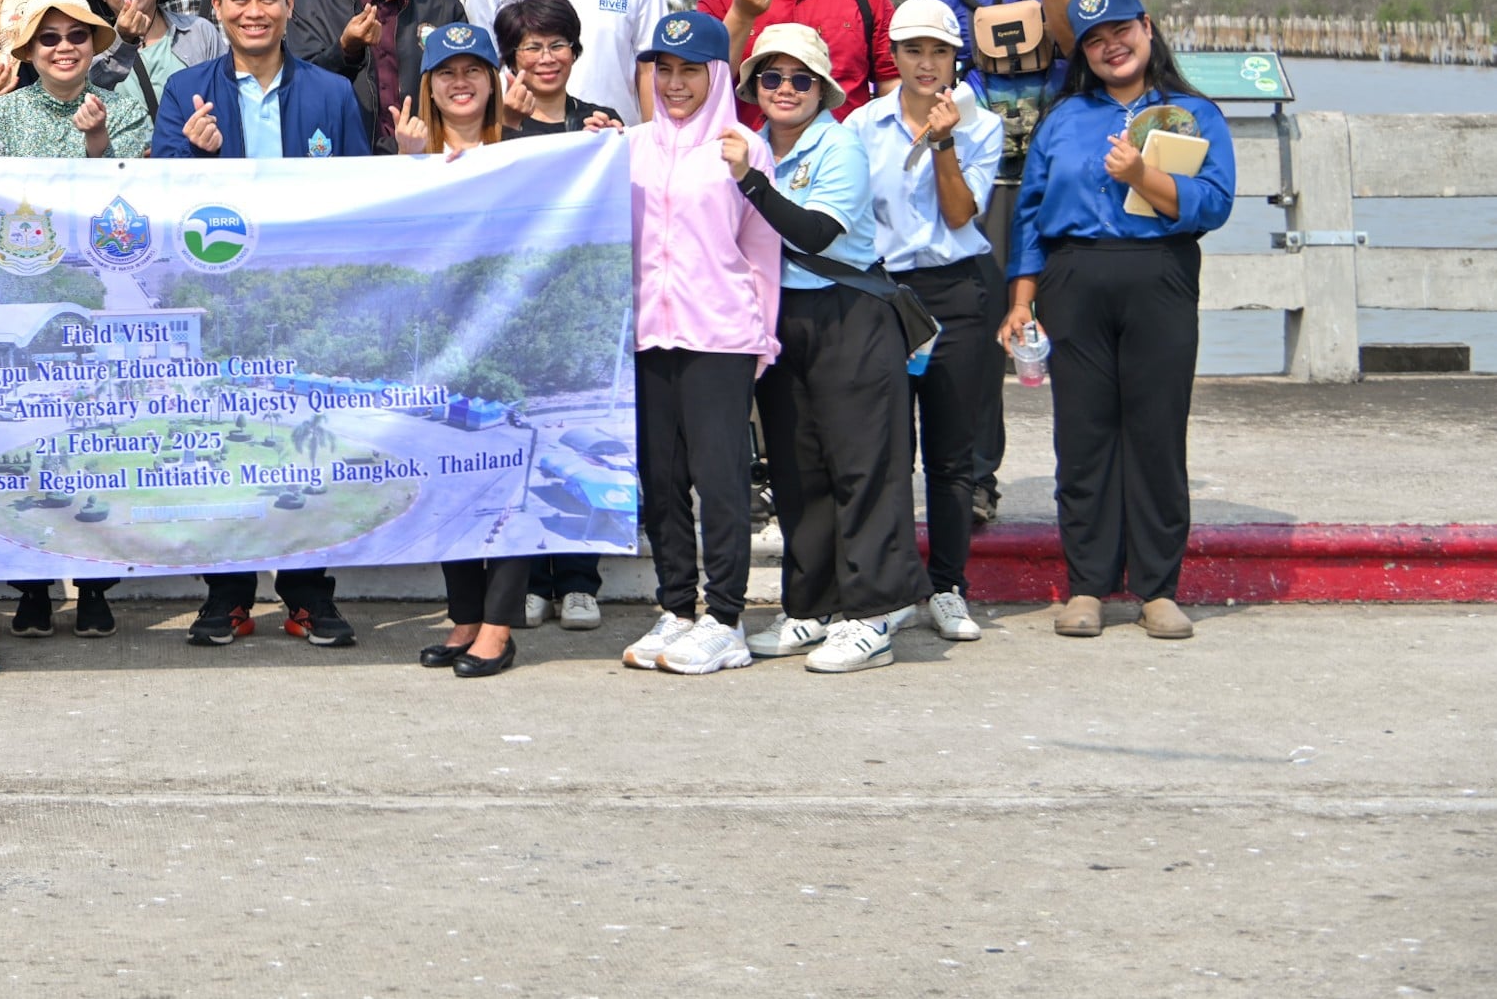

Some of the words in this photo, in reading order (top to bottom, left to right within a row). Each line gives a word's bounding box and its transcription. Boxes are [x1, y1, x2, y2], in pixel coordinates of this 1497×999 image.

[599, 0, 627, 10] RIVER
[209, 217, 240, 227] IBRRI
[63, 325, 112, 345] Field
[122, 323, 170, 343] Visit
[37, 362, 108, 381] Nature
[117, 357, 218, 379] Education
[228, 355, 295, 377] Center
[14, 398, 139, 420] Anniversary
[148, 394, 169, 414] of
[176, 393, 211, 413] her
[220, 391, 298, 414] Majesty
[308, 389, 372, 410] Queen
[382, 384, 449, 407] Sirikit
[36, 438, 58, 455] 21
[69, 433, 162, 454] February
[172, 432, 222, 450] 2025
[39, 468, 127, 494] Regional
[136, 465, 231, 489] Initiative
[240, 462, 321, 486] Meeting
[331, 458, 430, 483] Bangkok,
[438, 448, 523, 475] Thailand
